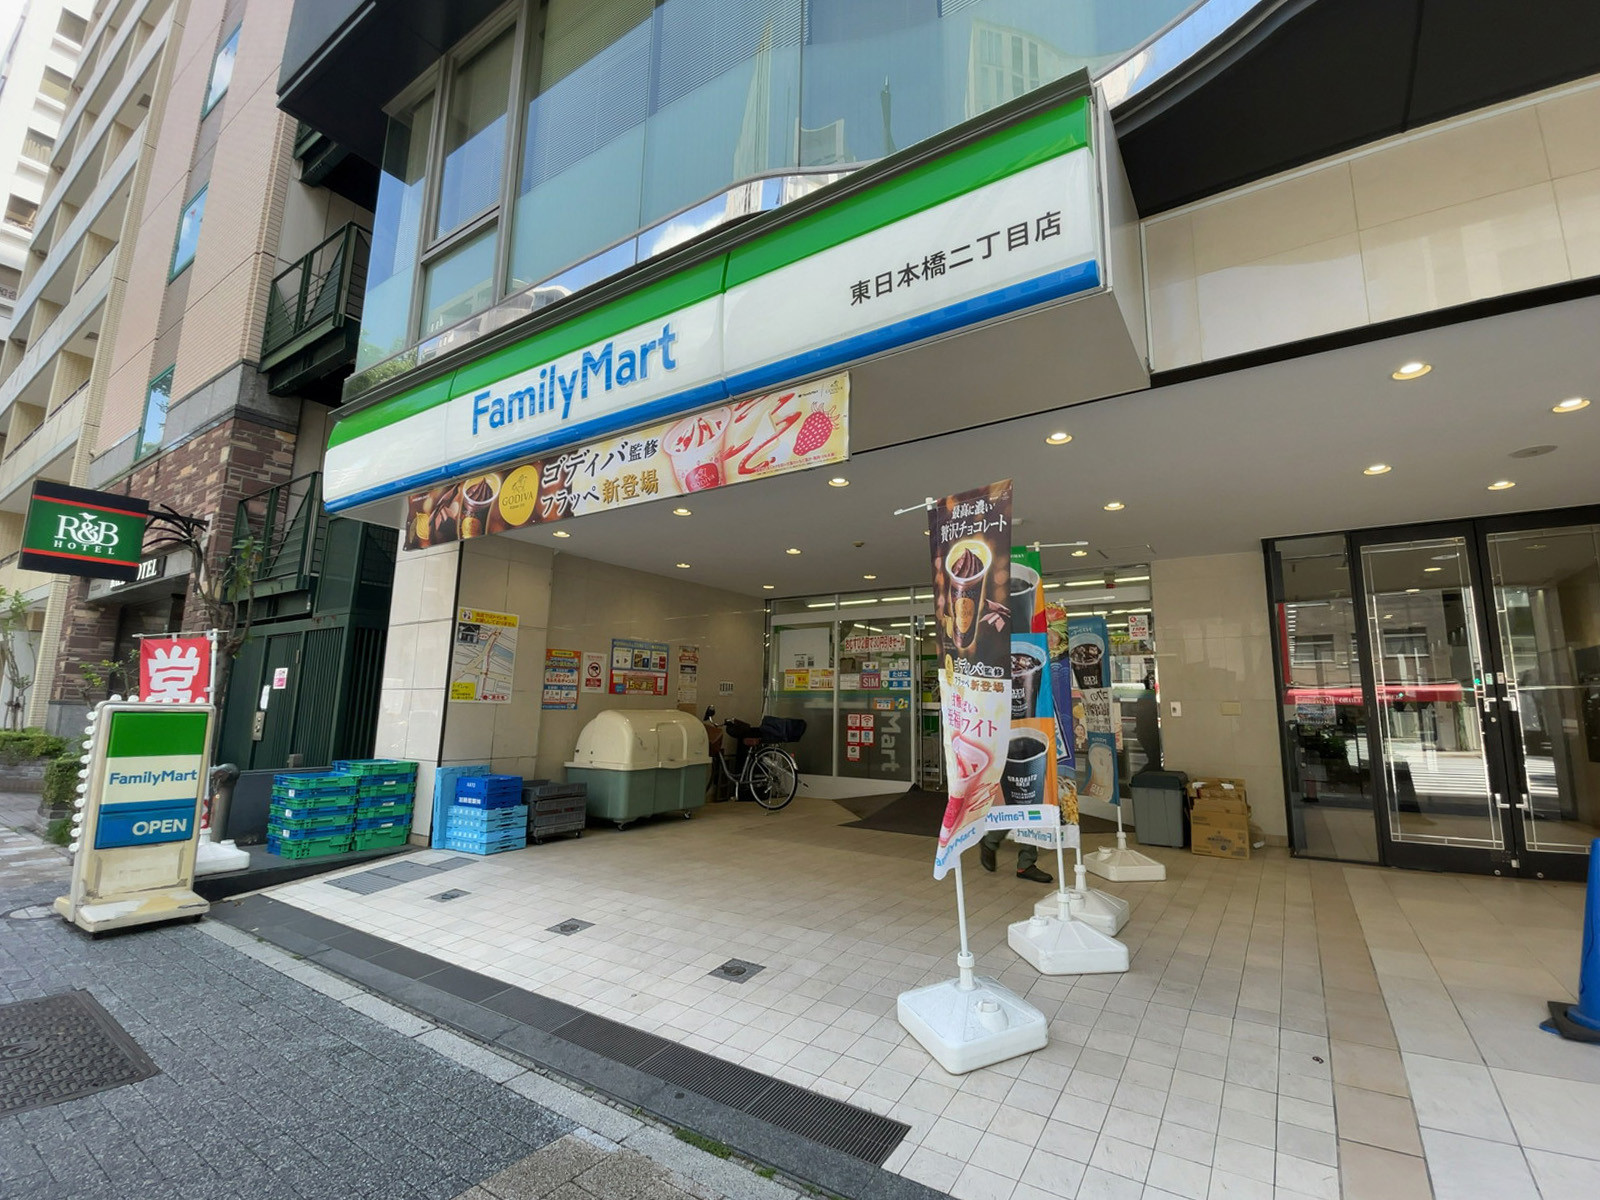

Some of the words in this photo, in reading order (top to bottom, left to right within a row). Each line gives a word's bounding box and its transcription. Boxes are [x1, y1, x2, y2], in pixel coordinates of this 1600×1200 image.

[850, 210, 1062, 306] 東日本橋二丁目店
[472, 323, 677, 436] FamilyMart
[542, 439, 659, 487] ゴディバ監修
[502, 491, 534, 506] GODIVA
[54, 512, 119, 548] R&B
[941, 514, 1007, 543] 贅沢チョコレート
[54, 540, 115, 555] HOTEL
[863, 677, 879, 688] SIM
[109, 769, 197, 785] FamilyMart
[132, 818, 187, 836] OPEN
